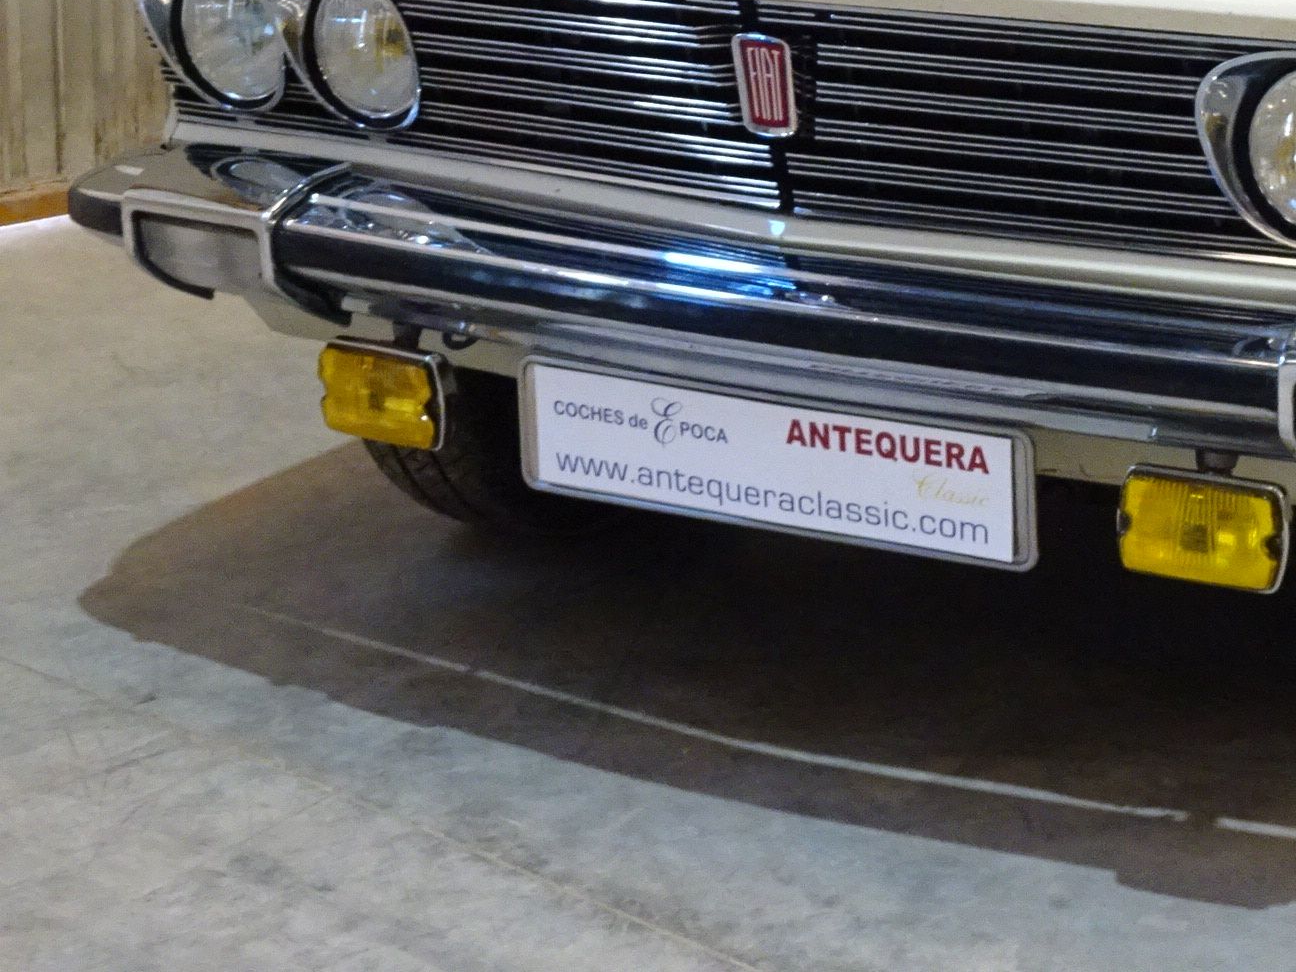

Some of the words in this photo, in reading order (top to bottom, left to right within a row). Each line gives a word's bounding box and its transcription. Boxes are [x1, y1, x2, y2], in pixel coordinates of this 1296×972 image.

[746, 46, 784, 122] FIAT
[553, 399, 625, 426] COCHES
[628, 413, 649, 430] de
[785, 418, 990, 475] ANTEQUERA
[555, 451, 989, 545] www.antequeraclassic.com
[914, 472, 991, 508] Classic
